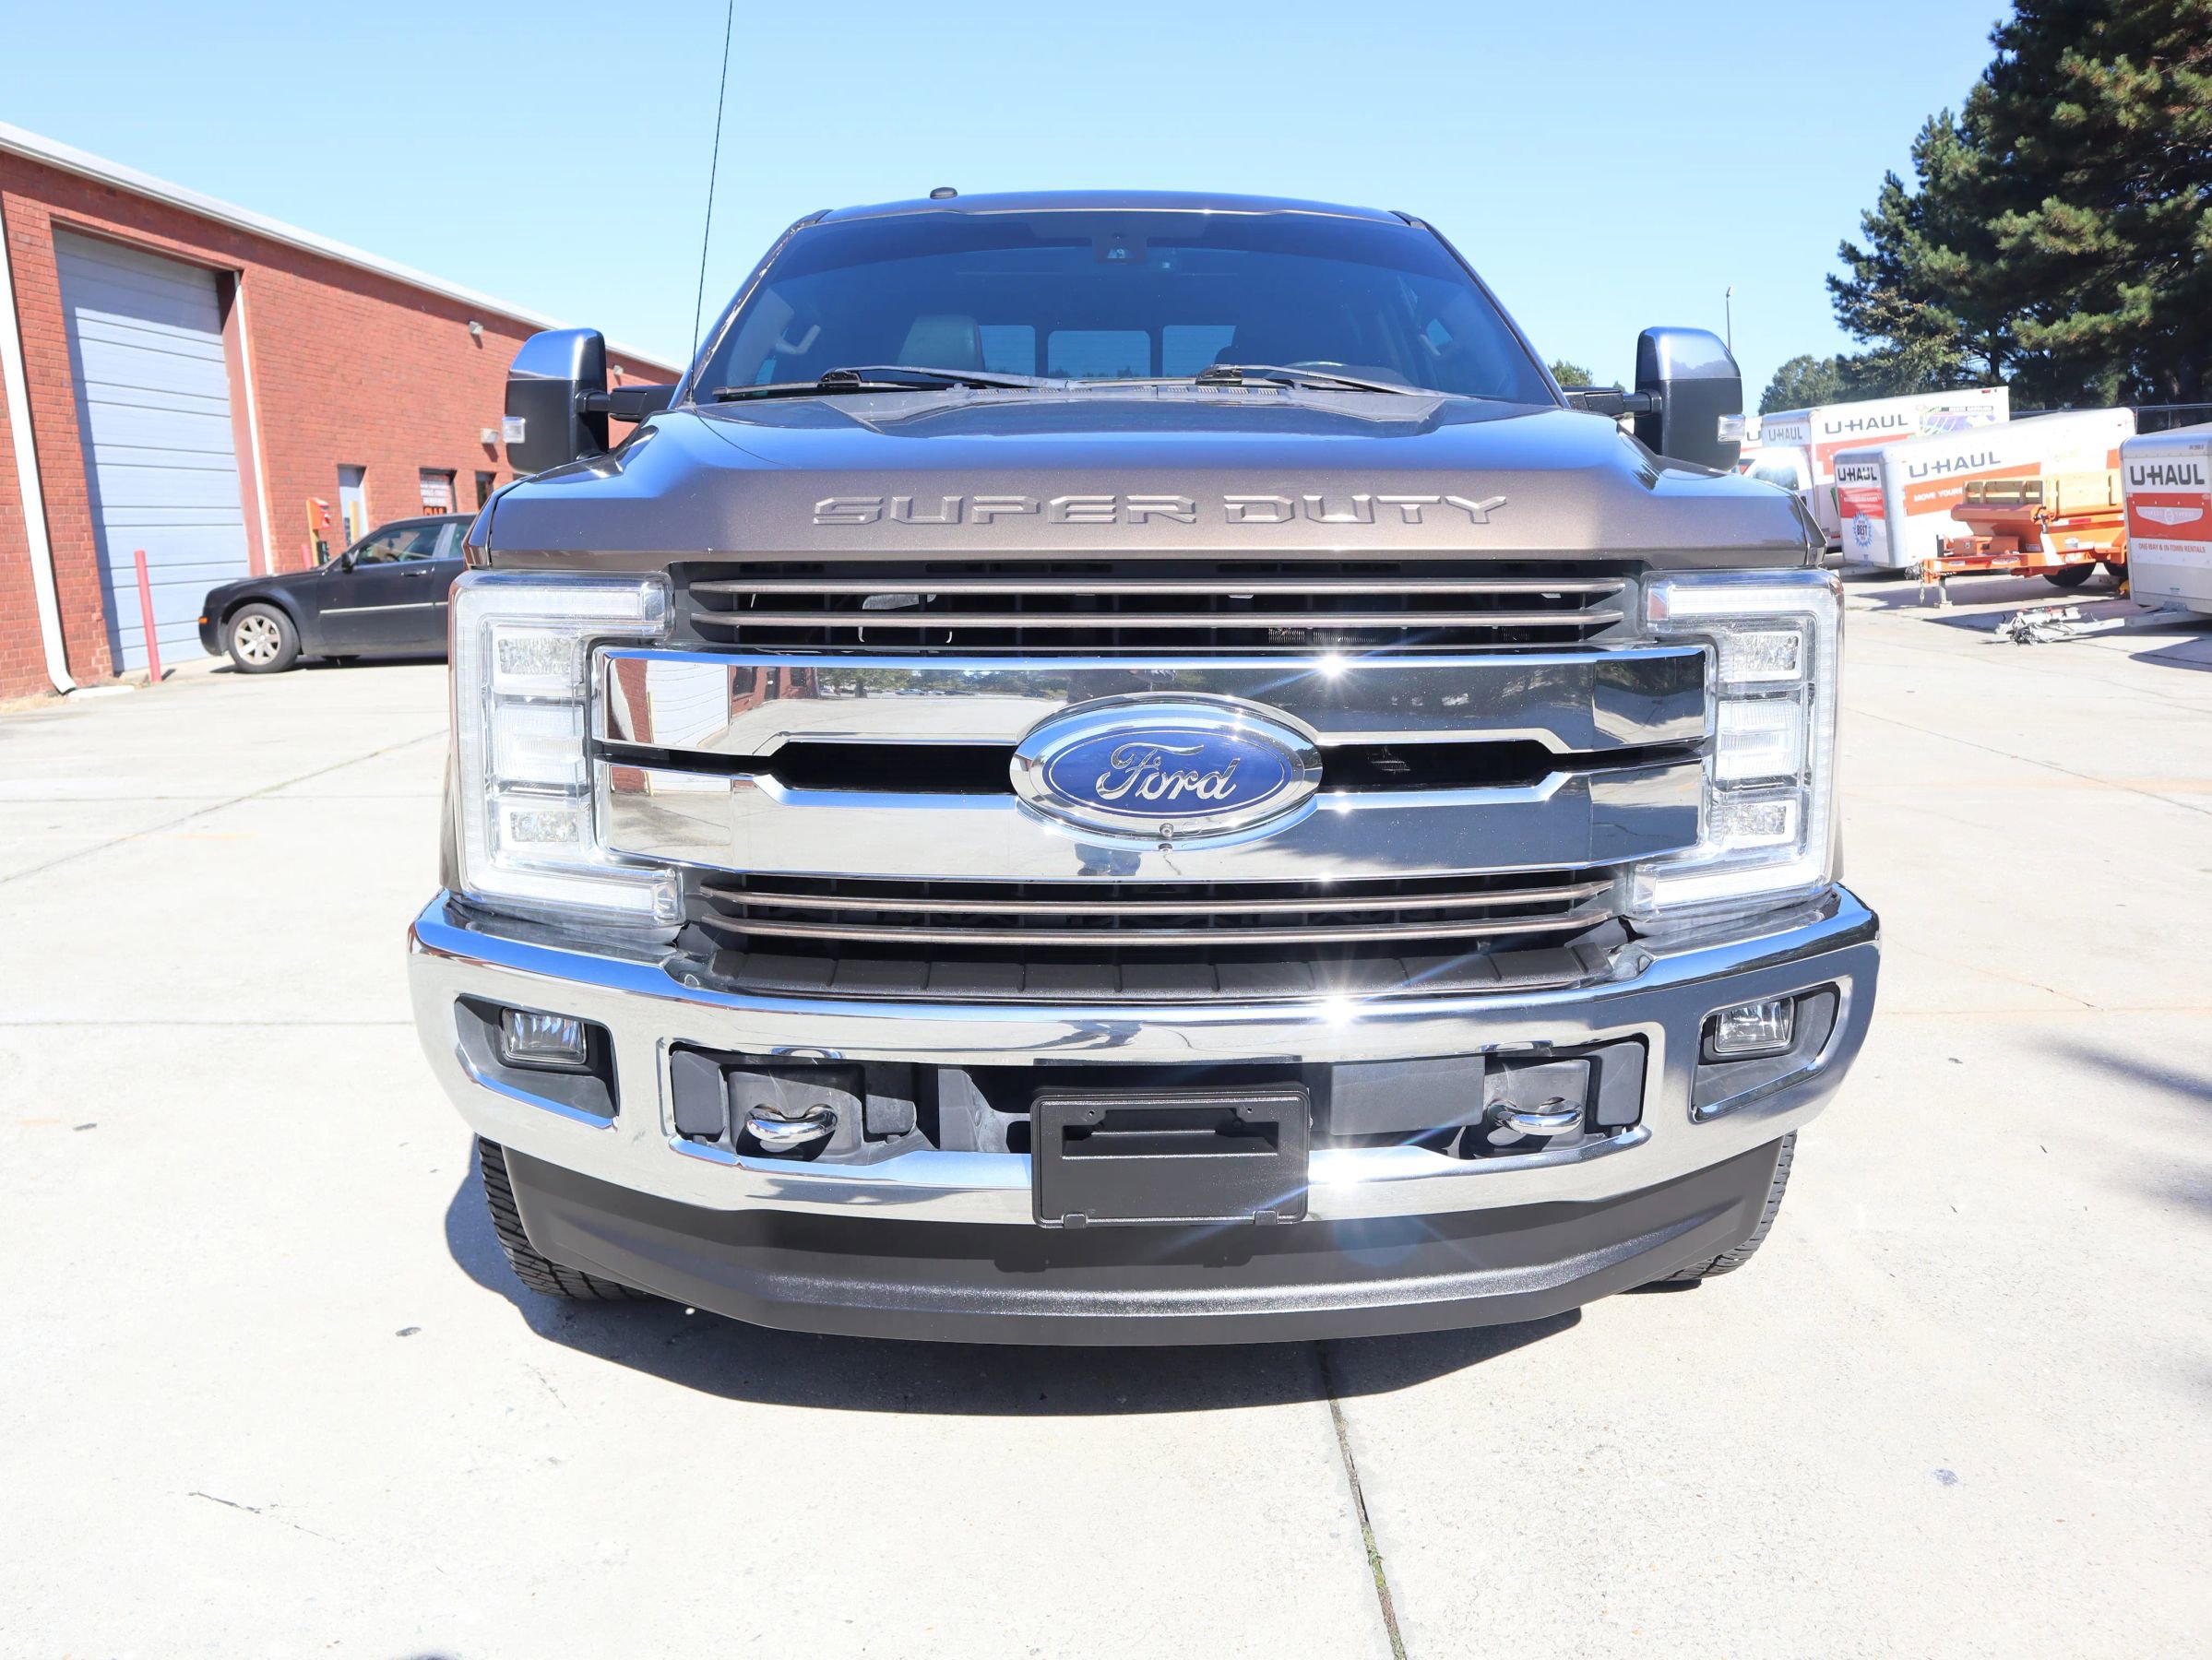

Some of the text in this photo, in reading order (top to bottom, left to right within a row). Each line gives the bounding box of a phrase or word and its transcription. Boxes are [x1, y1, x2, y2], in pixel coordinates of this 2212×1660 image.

[1768, 427, 1802, 442] U-HAUL
[1825, 414, 1909, 434] U-HAUL
[1837, 467, 1877, 481] U-HAUL
[1909, 451, 2001, 479] U-HAUL
[2130, 464, 2206, 486] U-HAUL
[1914, 492, 1936, 502] MOVE
[813, 493, 1508, 526] SUPER DUTY
[1095, 741, 1241, 800] Ford
